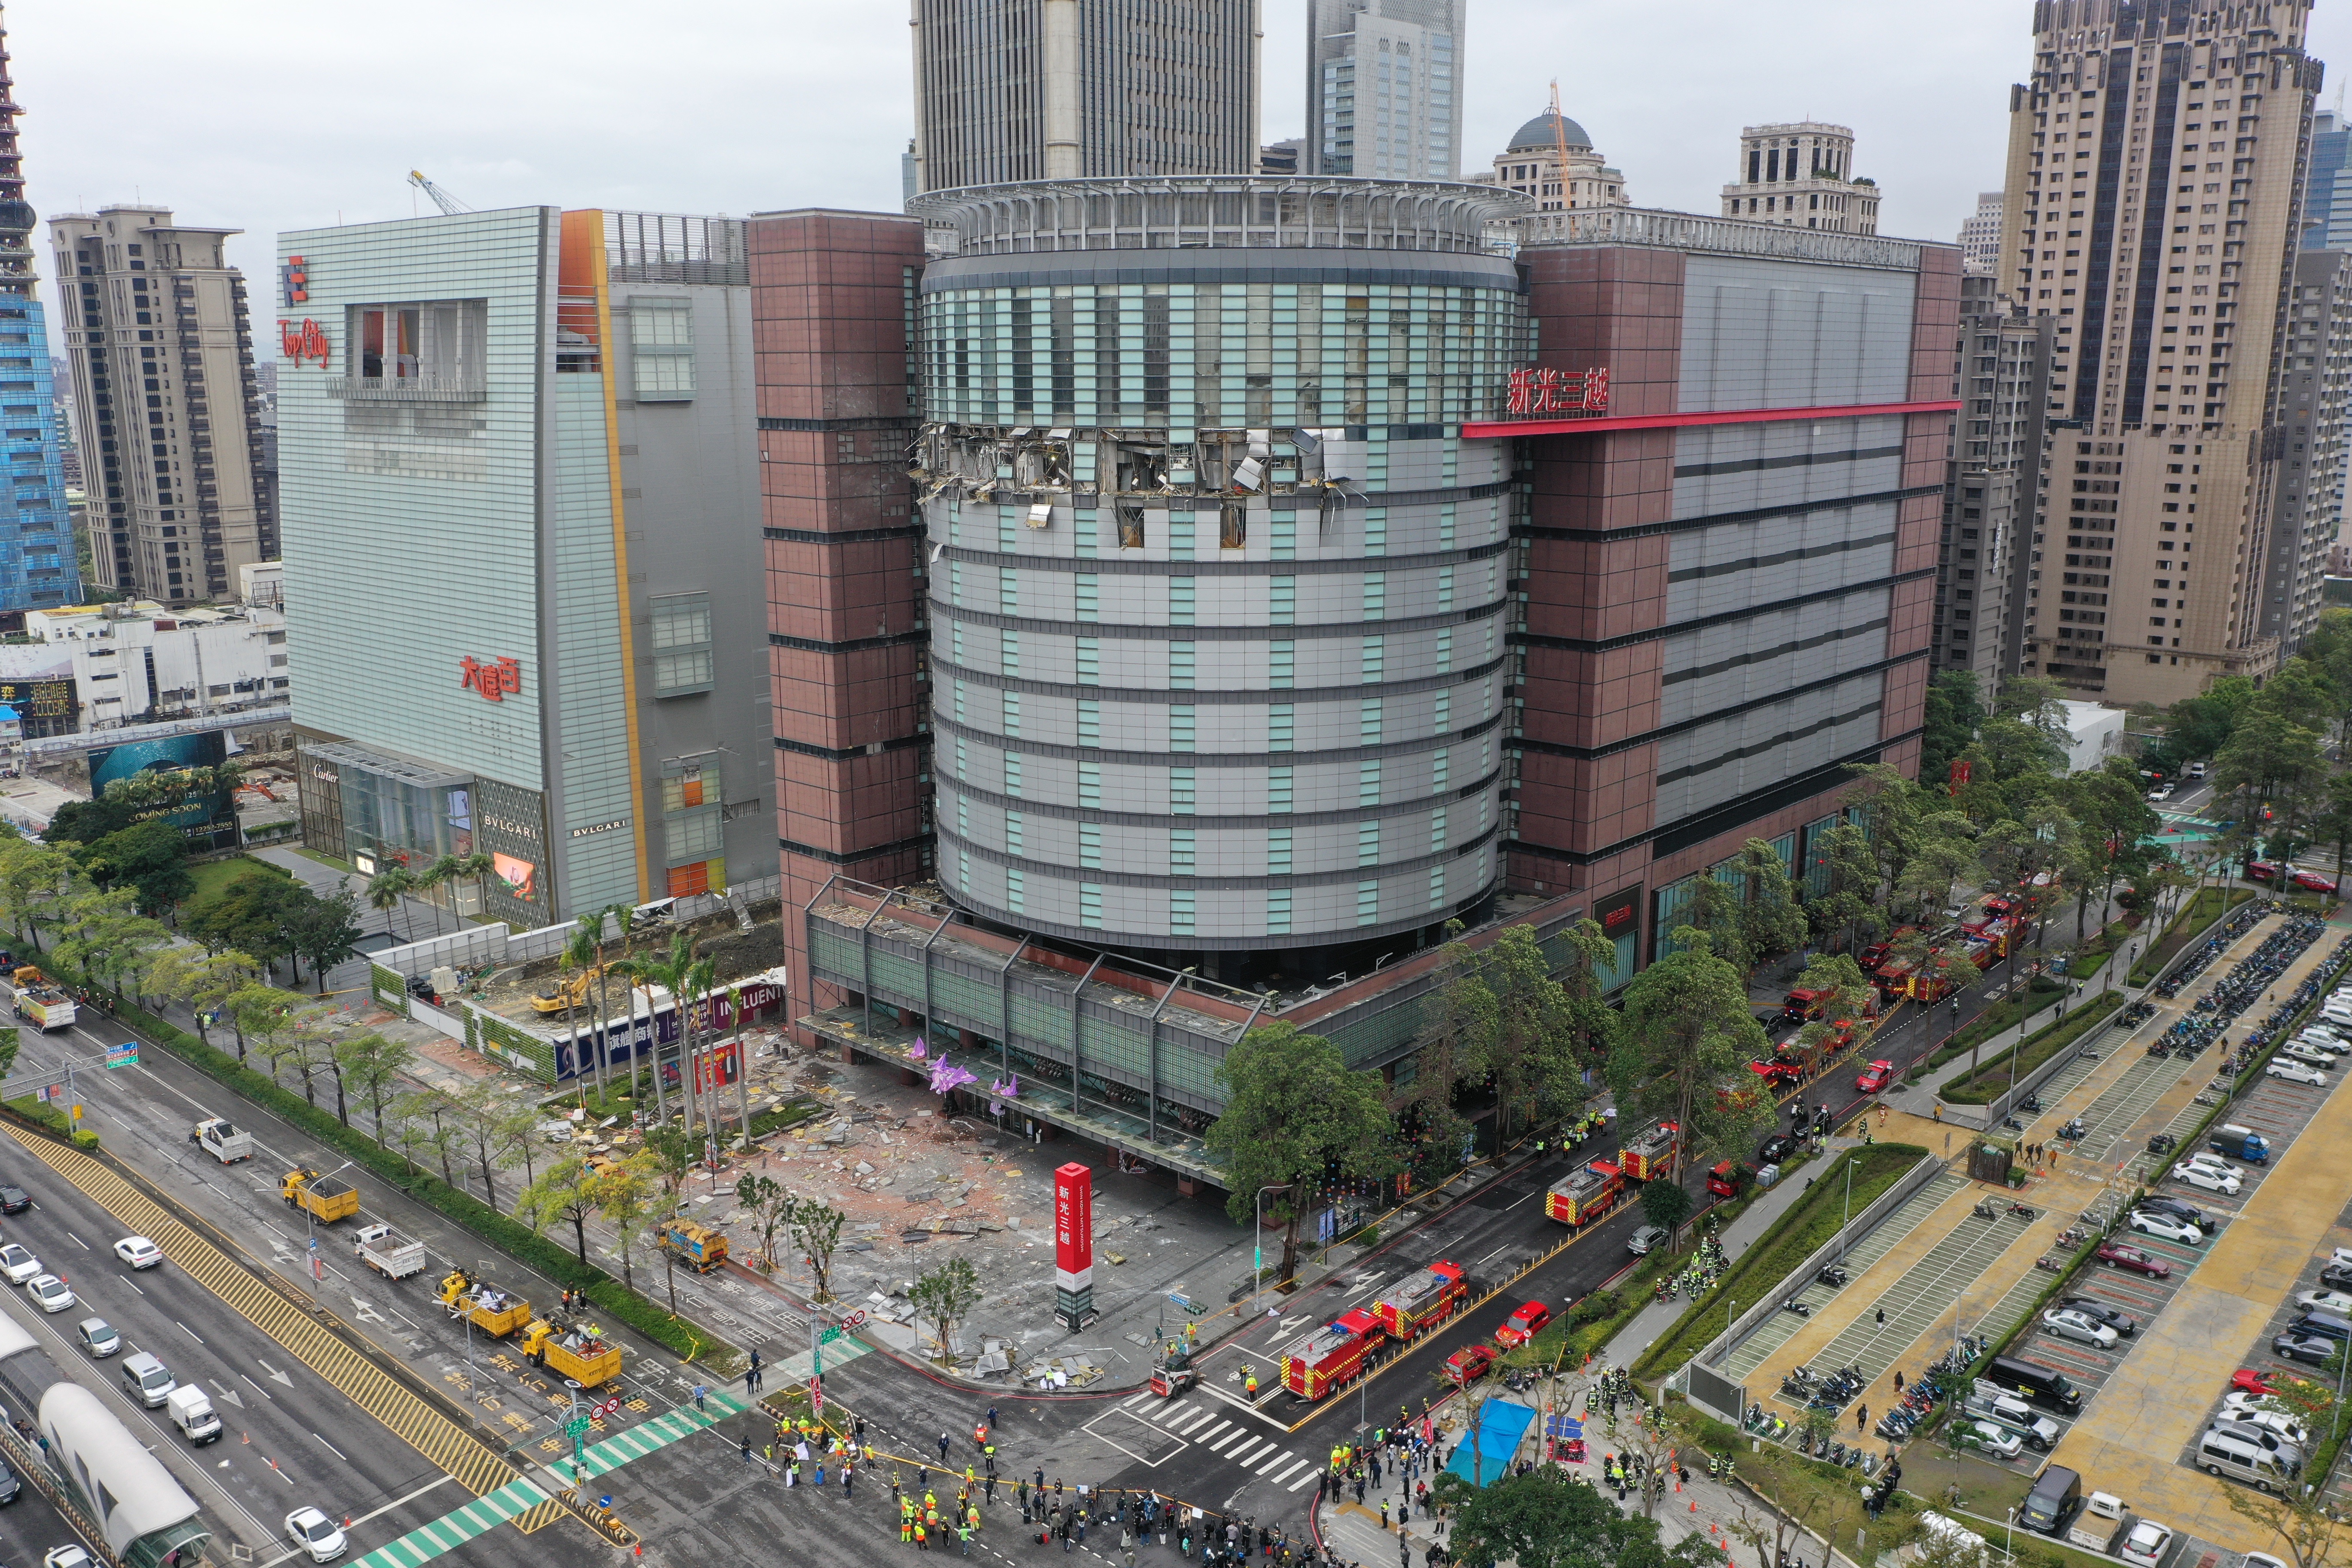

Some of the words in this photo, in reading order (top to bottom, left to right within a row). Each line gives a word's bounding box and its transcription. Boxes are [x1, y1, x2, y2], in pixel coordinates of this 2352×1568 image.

[1507, 367, 1609, 414] 新光三越
[459, 655, 520, 701] 大遠百
[314, 764, 338, 783] Cartier
[485, 815, 536, 839] BVLGARI
[573, 820, 625, 837] BVLGARI
[1059, 1185, 1070, 1245] 新光三越
